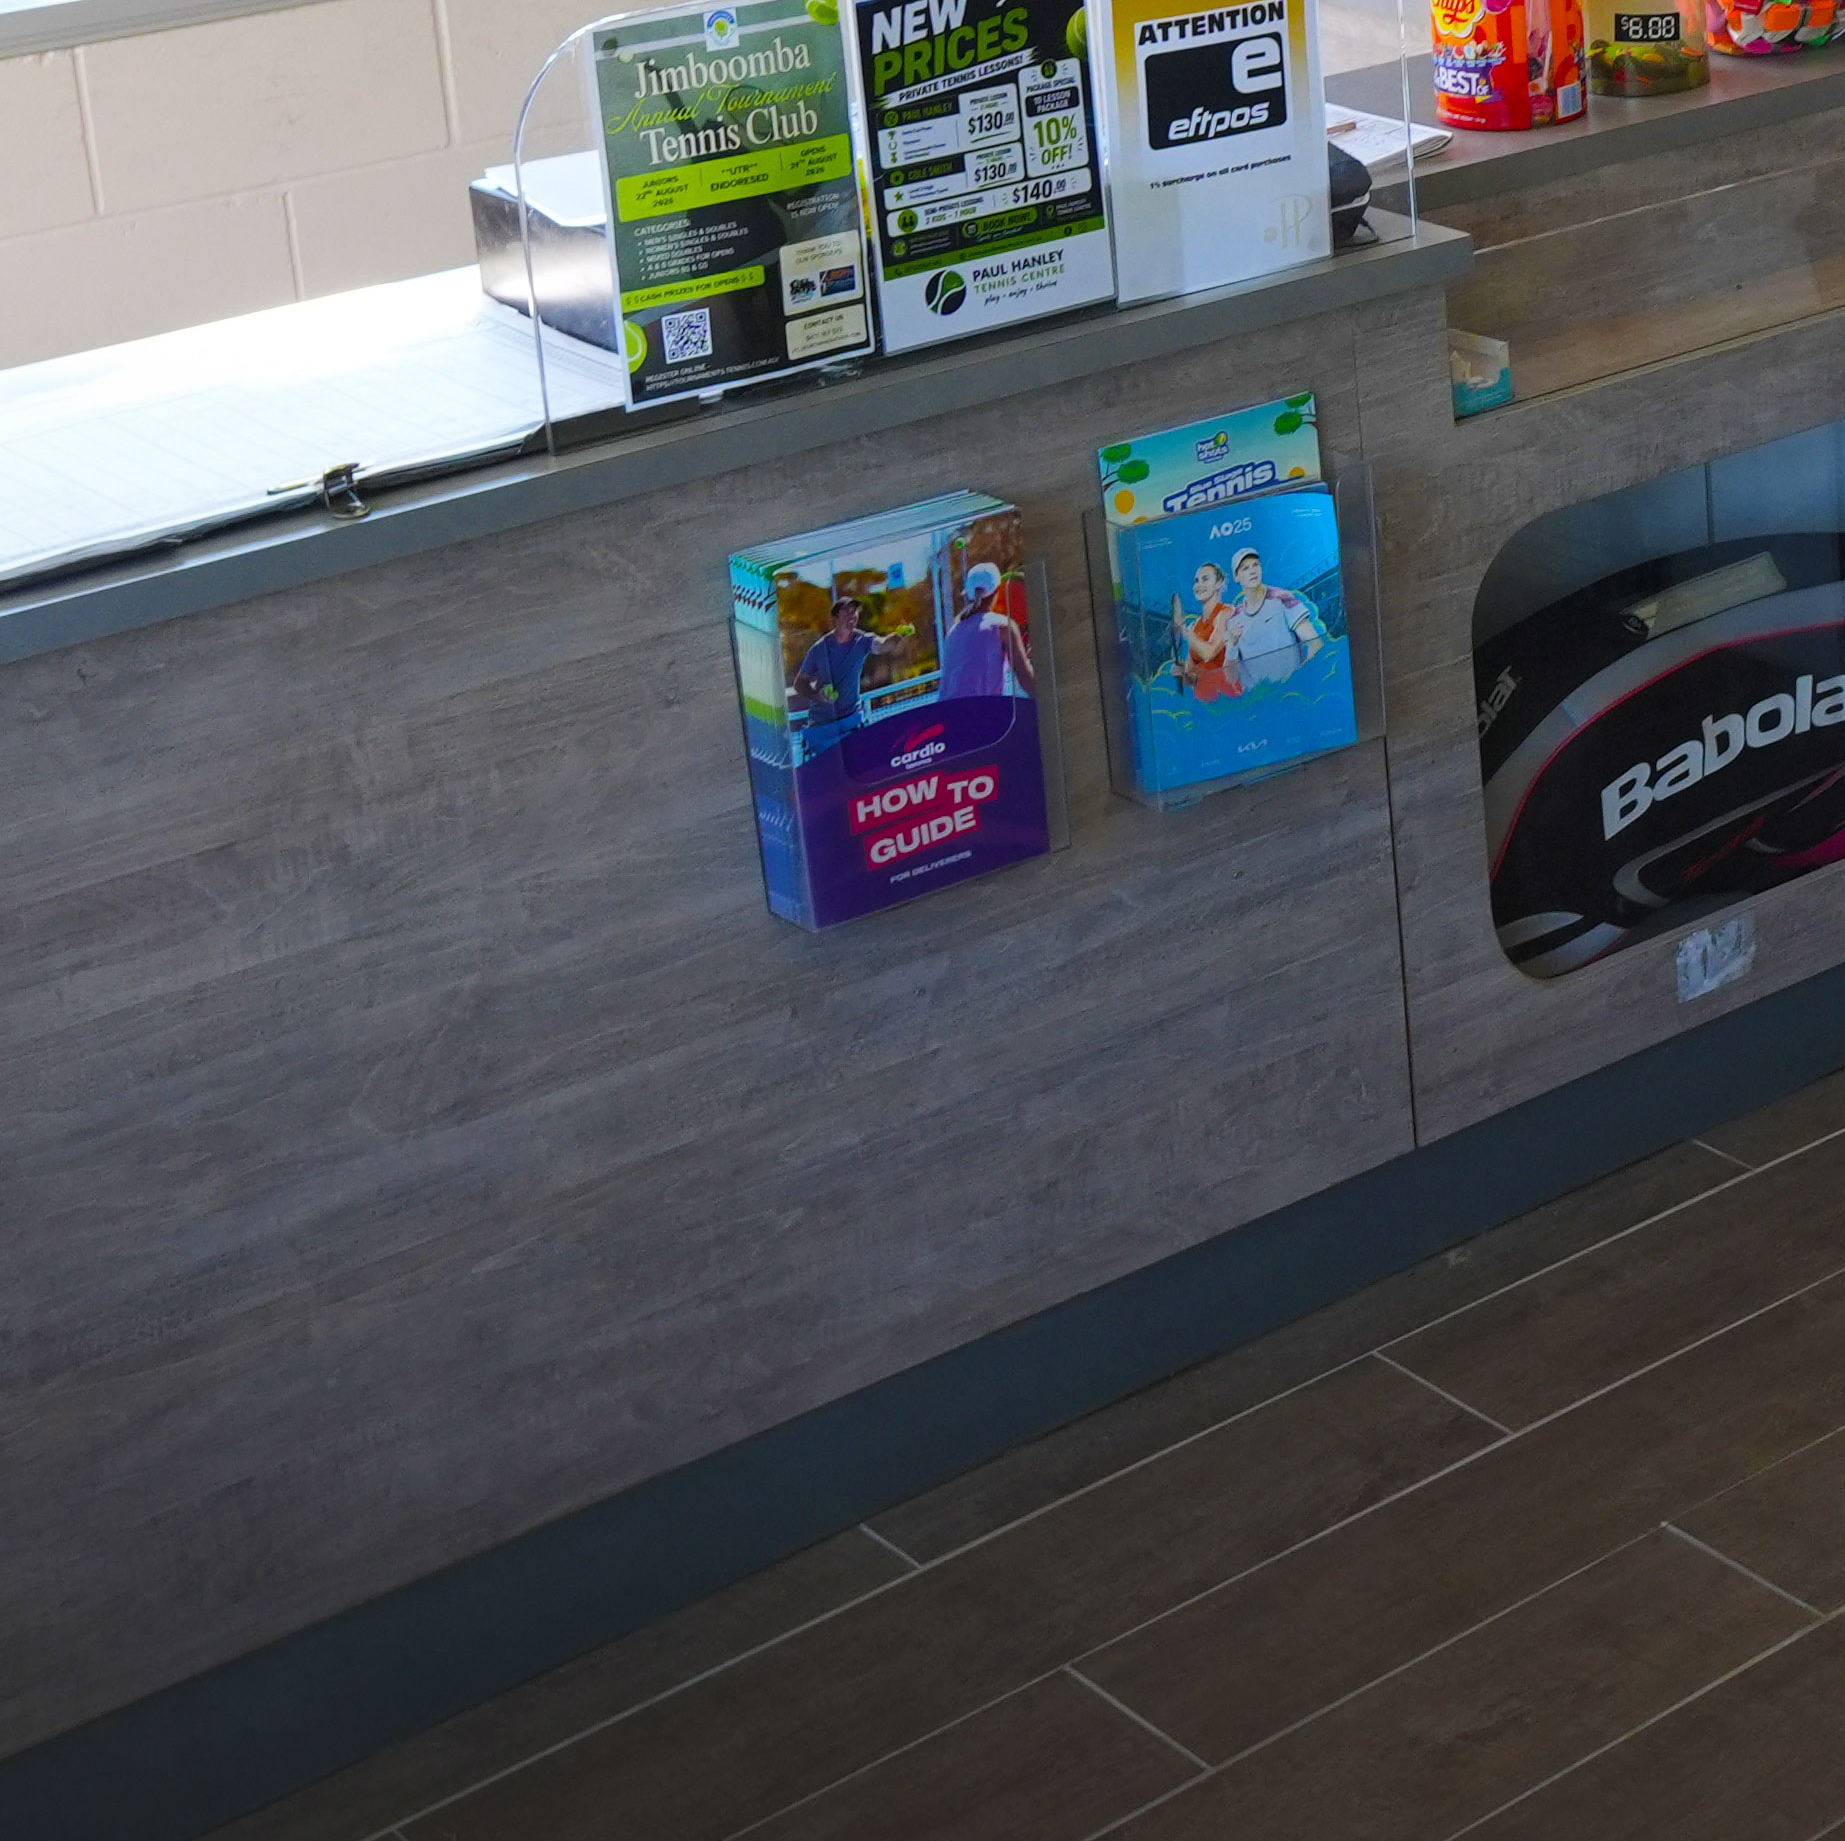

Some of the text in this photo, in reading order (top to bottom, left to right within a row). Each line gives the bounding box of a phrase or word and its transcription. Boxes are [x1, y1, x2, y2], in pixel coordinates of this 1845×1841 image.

[1138, 0, 1284, 45] ATTENTION
[635, 36, 811, 99] Jimboomba
[875, 8, 1028, 96] PRICES
[1231, 36, 1282, 94] e
[899, 55, 1023, 102] PRIVATE TENNIS LESSONS!
[1439, 68, 1478, 96] BEST
[608, 72, 837, 134] Annual Tournament
[1168, 102, 1270, 141] eftpos
[640, 101, 818, 165] Tennis Club
[1033, 114, 1077, 148] 10%
[1041, 144, 1072, 165] OFF!
[972, 266, 1008, 282] PAUL
[1012, 249, 1064, 271] HANLEY
[974, 264, 1065, 294] TENNIS CENTRE
[1164, 463, 1274, 512] Tennis
[890, 741, 946, 768] cardio
[856, 774, 995, 823] HOW TO
[871, 806, 976, 865] GUIDE
